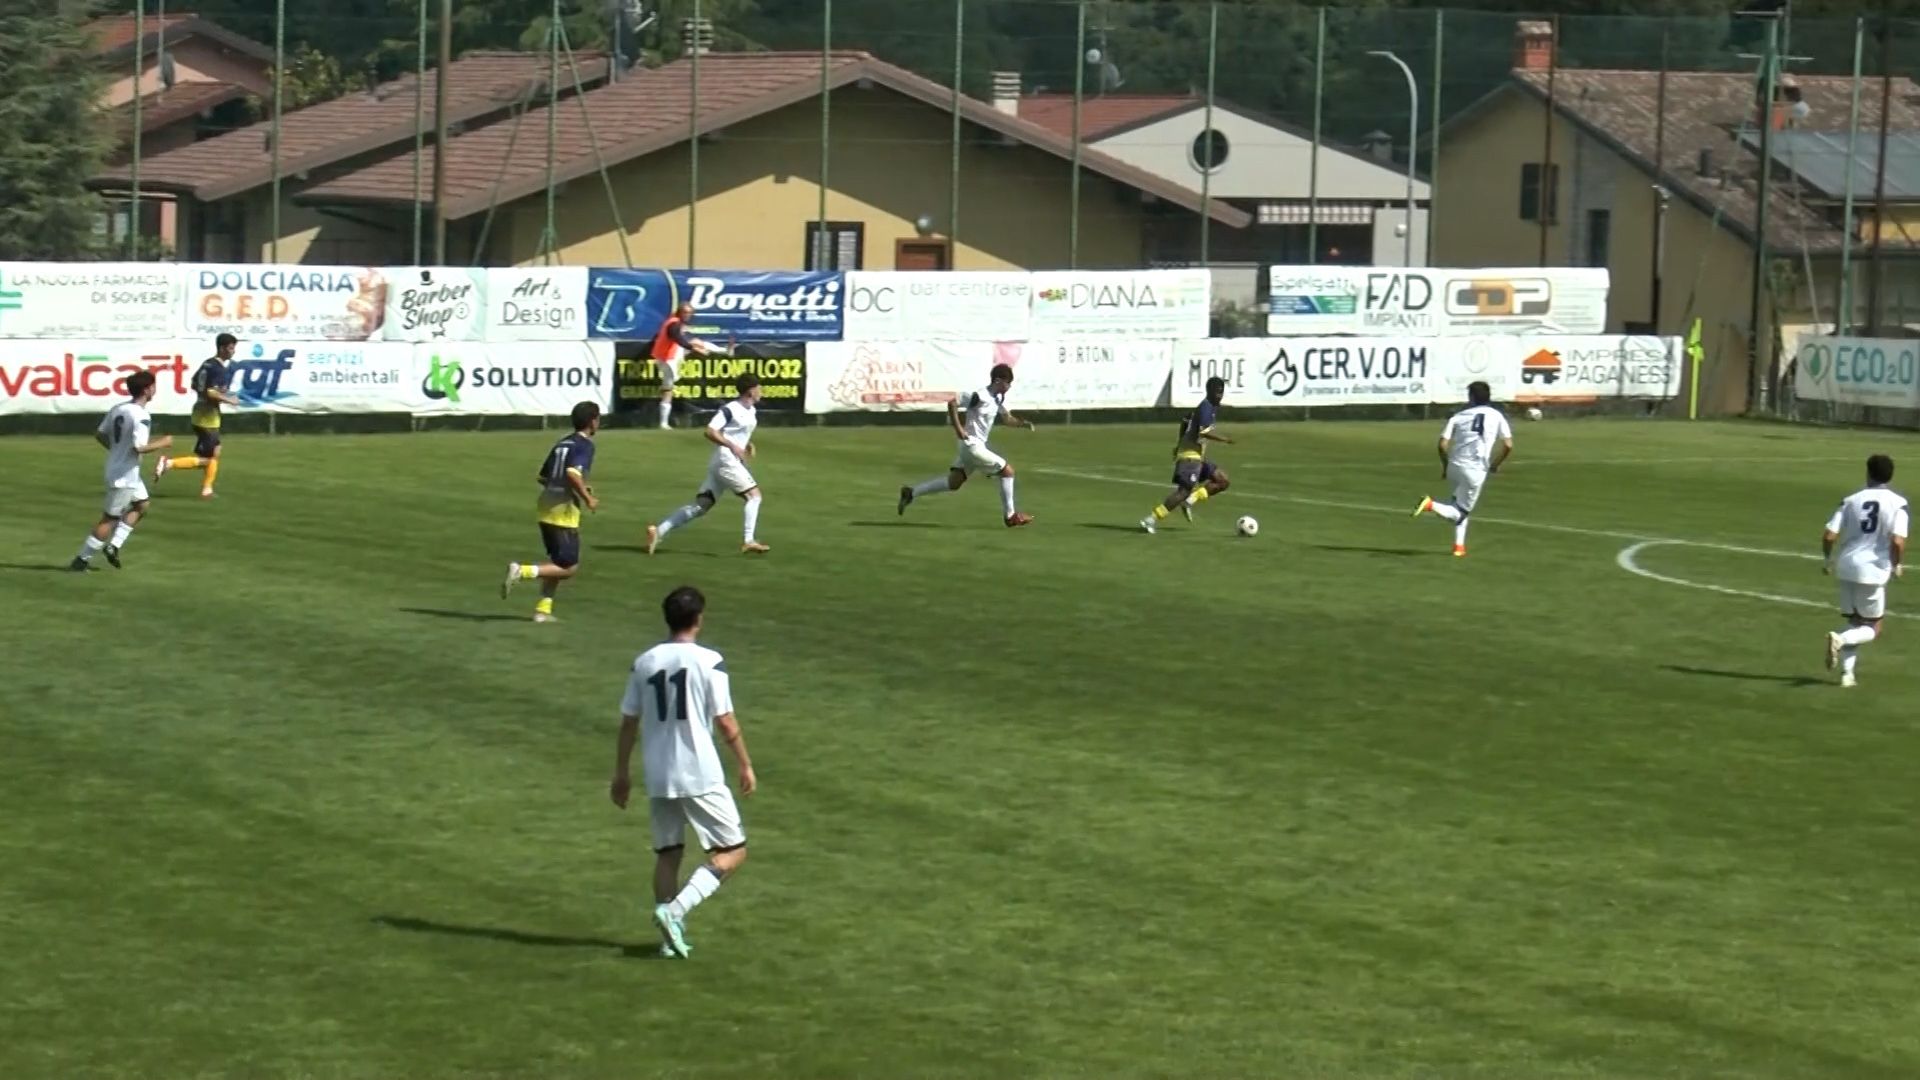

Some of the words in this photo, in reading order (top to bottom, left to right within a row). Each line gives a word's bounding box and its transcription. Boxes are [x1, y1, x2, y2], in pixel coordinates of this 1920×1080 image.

[200, 271, 354, 292] DOLCIARIA
[512, 278, 552, 297] Art
[686, 277, 840, 311] Bonetti
[1071, 279, 1158, 309] DIANA
[1365, 273, 1433, 311] FAD
[401, 284, 471, 310] Barber
[402, 308, 453, 331] Shop
[503, 301, 575, 329] Design
[309, 369, 399, 384] ambientali
[472, 367, 602, 387] SOLUTION
[1861, 500, 1880, 534] 3
[647, 668, 688, 721] 11
